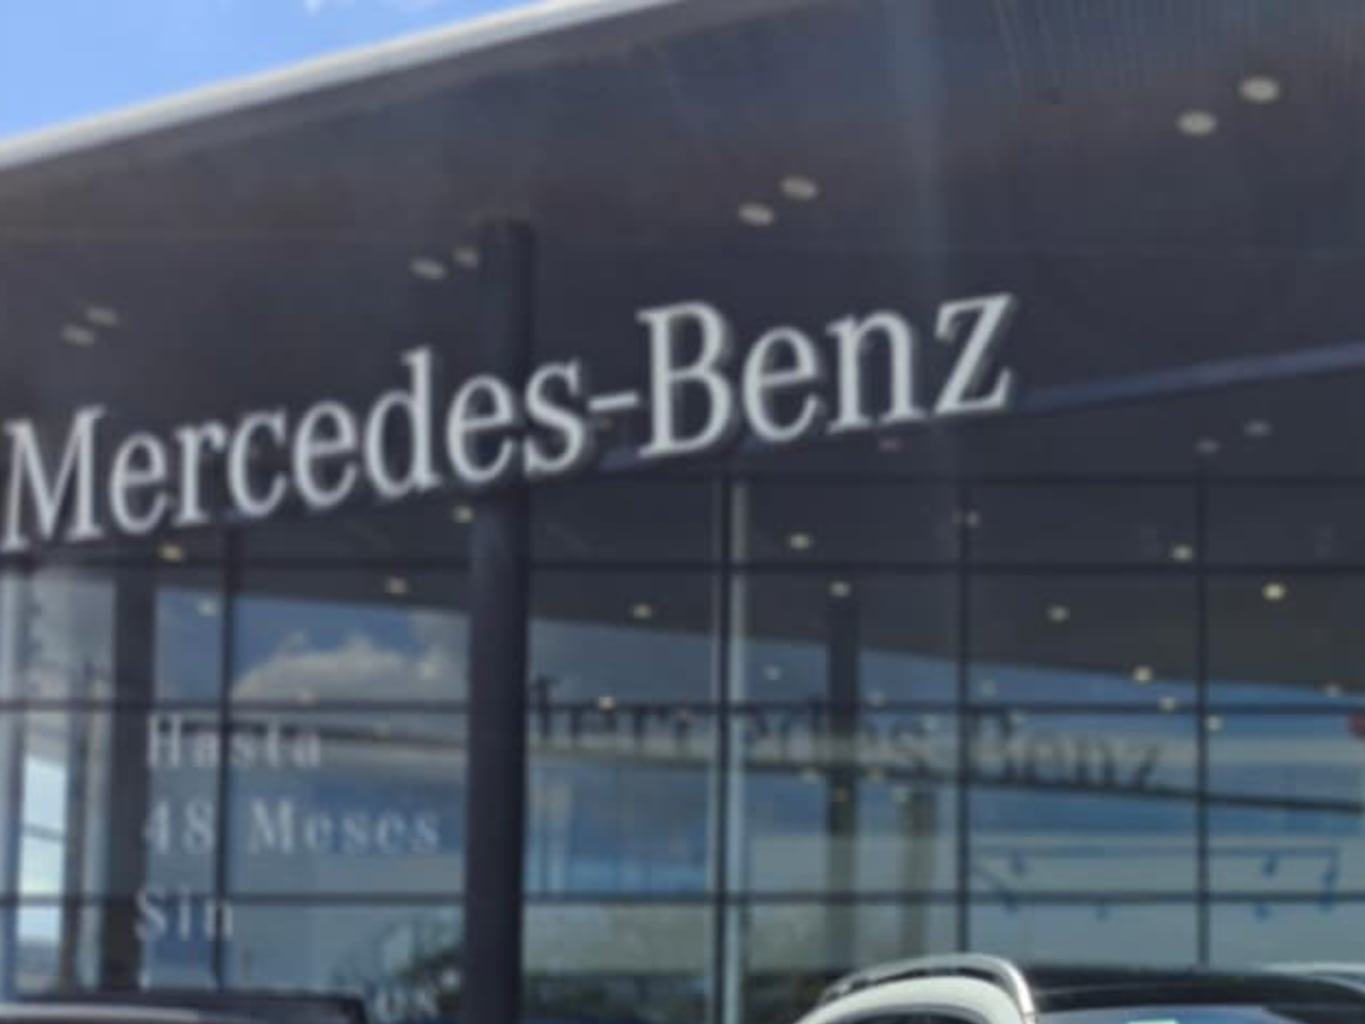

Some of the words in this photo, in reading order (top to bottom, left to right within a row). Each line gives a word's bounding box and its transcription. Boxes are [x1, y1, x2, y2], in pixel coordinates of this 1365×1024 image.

[0, 293, 1014, 552] Mercedes-Benz
[146, 714, 322, 769] Hasta
[142, 800, 215, 856] 48
[248, 799, 441, 856] Meses
